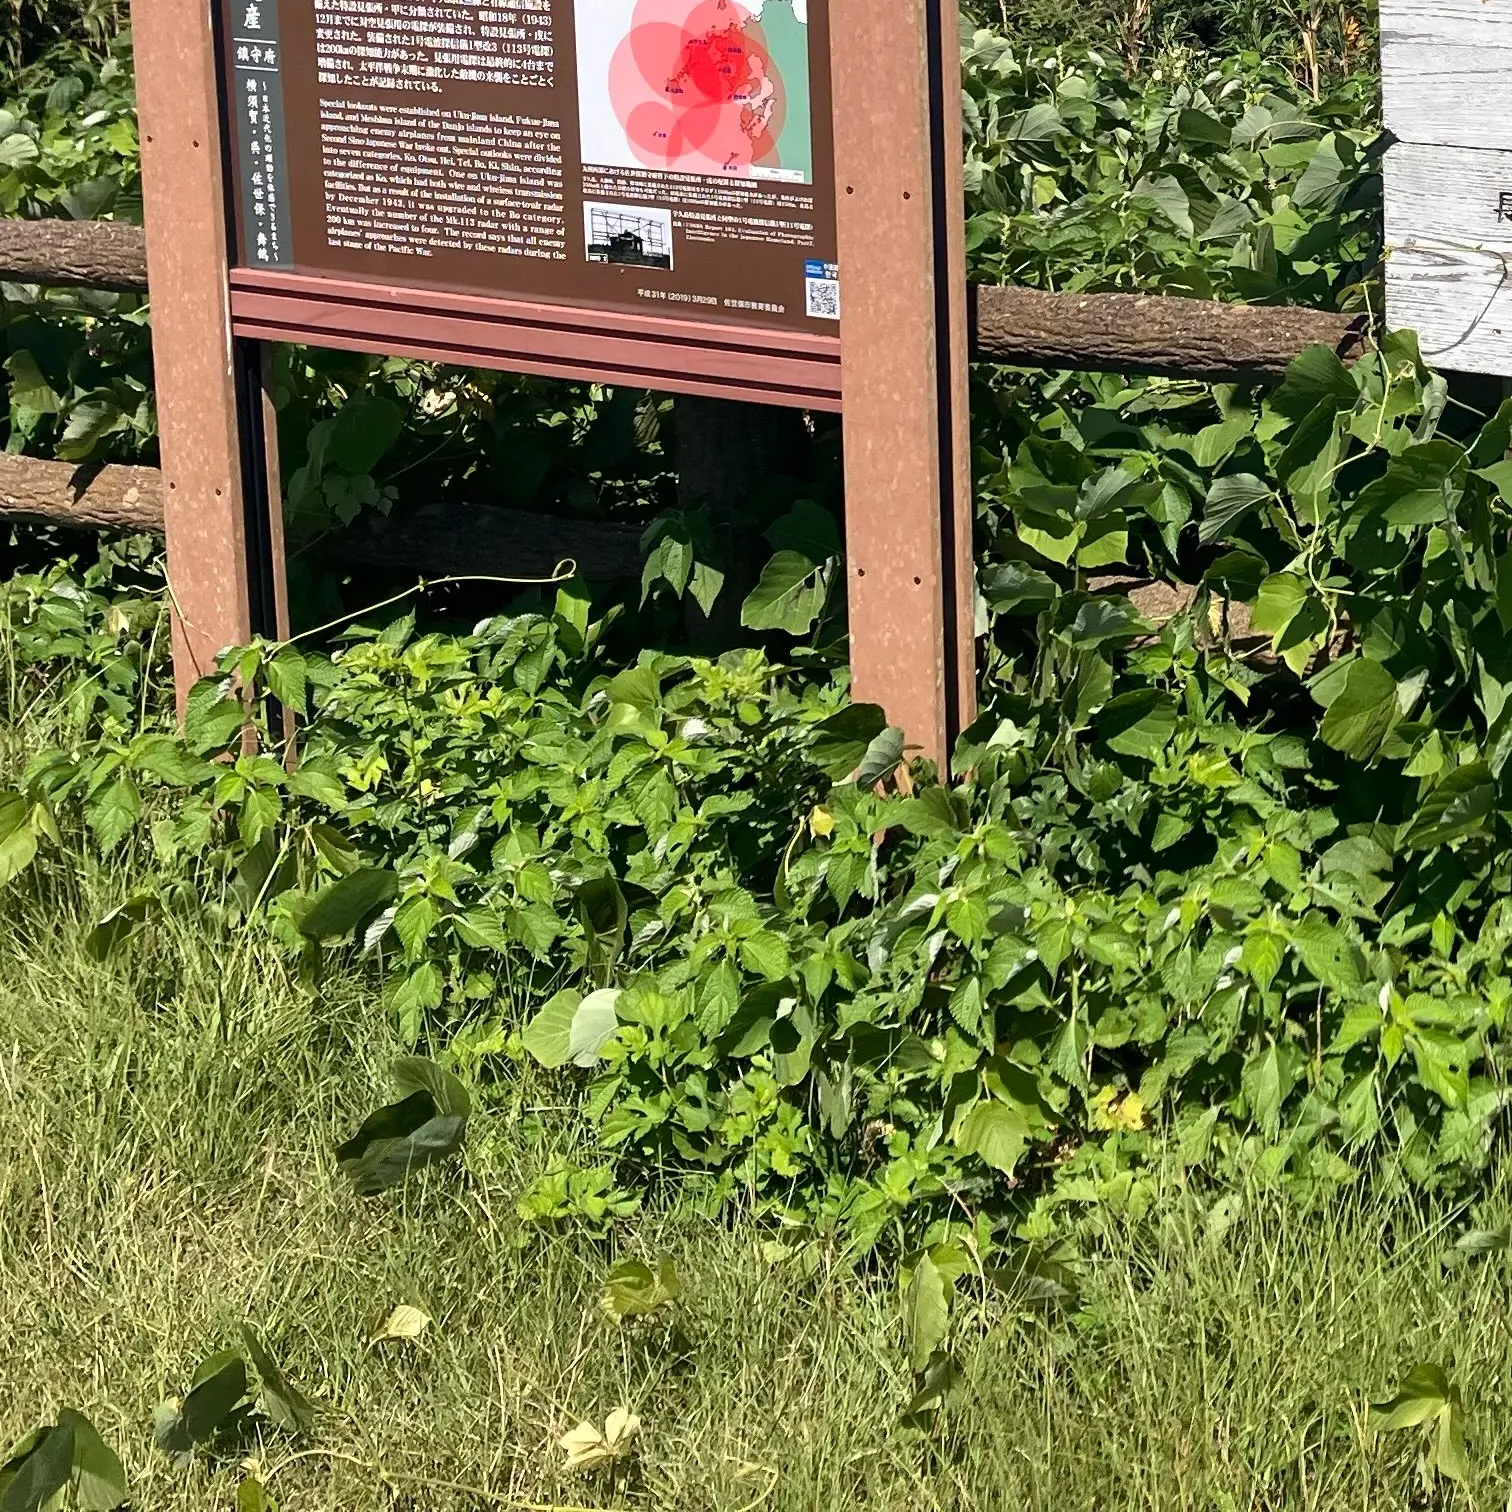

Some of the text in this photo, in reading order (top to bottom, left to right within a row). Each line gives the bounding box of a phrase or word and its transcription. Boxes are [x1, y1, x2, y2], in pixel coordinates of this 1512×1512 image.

[236, 46, 277, 65] 鎮守府
[379, 105, 397, 113] were
[344, 112, 358, 121] and
[417, 119, 426, 127] of
[427, 120, 440, 129] the
[493, 126, 501, 135] to
[436, 132, 455, 142] from
[457, 134, 495, 146] mainland
[497, 138, 521, 148] China
[524, 141, 544, 151] after
[546, 143, 560, 152] the
[323, 157, 331, 165] to
[333, 158, 346, 167] the
[389, 163, 398, 172] of
[448, 169, 465, 178] One
[466, 182, 480, 191] and
[325, 191, 335, 202] by
[338, 193, 379, 205] December
[479, 207, 488, 216] to
[491, 208, 505, 218] the
[410, 188, 418, 197] of
[420, 189, 432, 198] the
[476, 195, 485, 203] of
[543, 201, 563, 211] radar
[326, 203, 369, 217] Eventually
[371, 208, 384, 217] the
[419, 213, 427, 221] of
[430, 214, 443, 223] the
[477, 219, 498, 229] radar
[501, 221, 520, 231] with
[556, 226, 565, 235] of
[411, 224, 419, 232] to
[421, 225, 438, 234] four.
[444, 227, 459, 236] The
[507, 233, 523, 243] that
[363, 241, 371, 250] of
[373, 242, 386, 251] the
[408, 237, 426, 245] were
[463, 240, 473, 251] by
[552, 250, 565, 259] the
